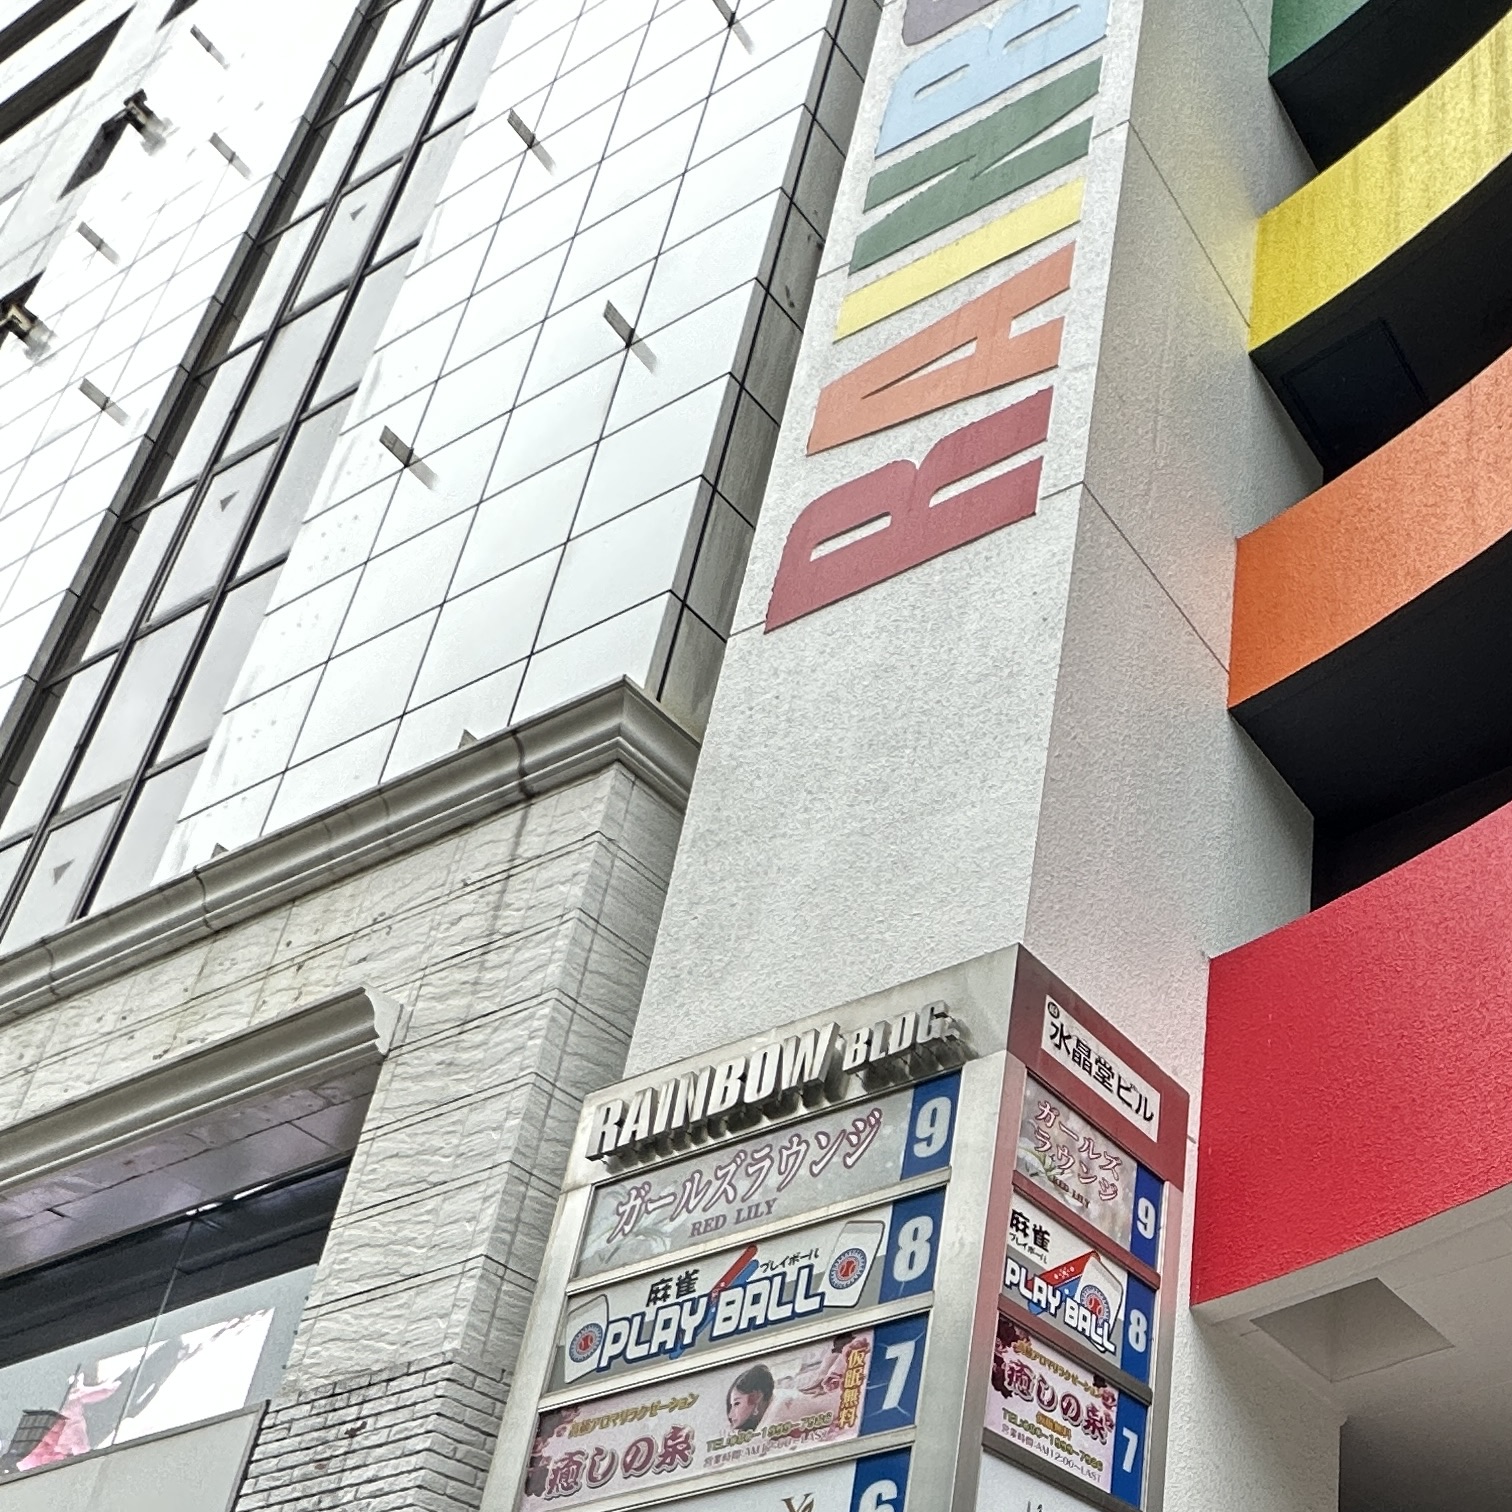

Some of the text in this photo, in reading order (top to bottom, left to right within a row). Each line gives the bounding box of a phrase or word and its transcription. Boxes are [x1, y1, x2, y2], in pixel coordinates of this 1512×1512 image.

[765, 0, 1109, 634] RAINB
[586, 1022, 839, 1159] RAINBOW
[1050, 1021, 1154, 1122] 水晶堂ビル
[913, 1096, 952, 1159] 9
[1035, 1100, 1122, 1181] ガールズ
[607, 1108, 883, 1244] ガールズラウンジ
[1034, 1128, 1118, 1200] ラウンジ
[690, 1199, 777, 1238] RED LILY
[893, 1216, 933, 1283] 8
[1010, 1209, 1050, 1252] 麻雀
[1137, 1197, 1156, 1240] 9
[646, 1269, 699, 1307] 麻雀
[759, 1249, 819, 1273] プレイボール
[597, 1264, 827, 1372] PLAY BALL
[1004, 1259, 1116, 1356] PLAY BALL
[1129, 1309, 1148, 1353] 8
[837, 1347, 864, 1429] 仮眠無料
[883, 1341, 915, 1410] 7
[1004, 1360, 1112, 1444] 癒しの泉
[545, 1425, 695, 1500] 癒しの泉
[1122, 1427, 1138, 1473] 7
